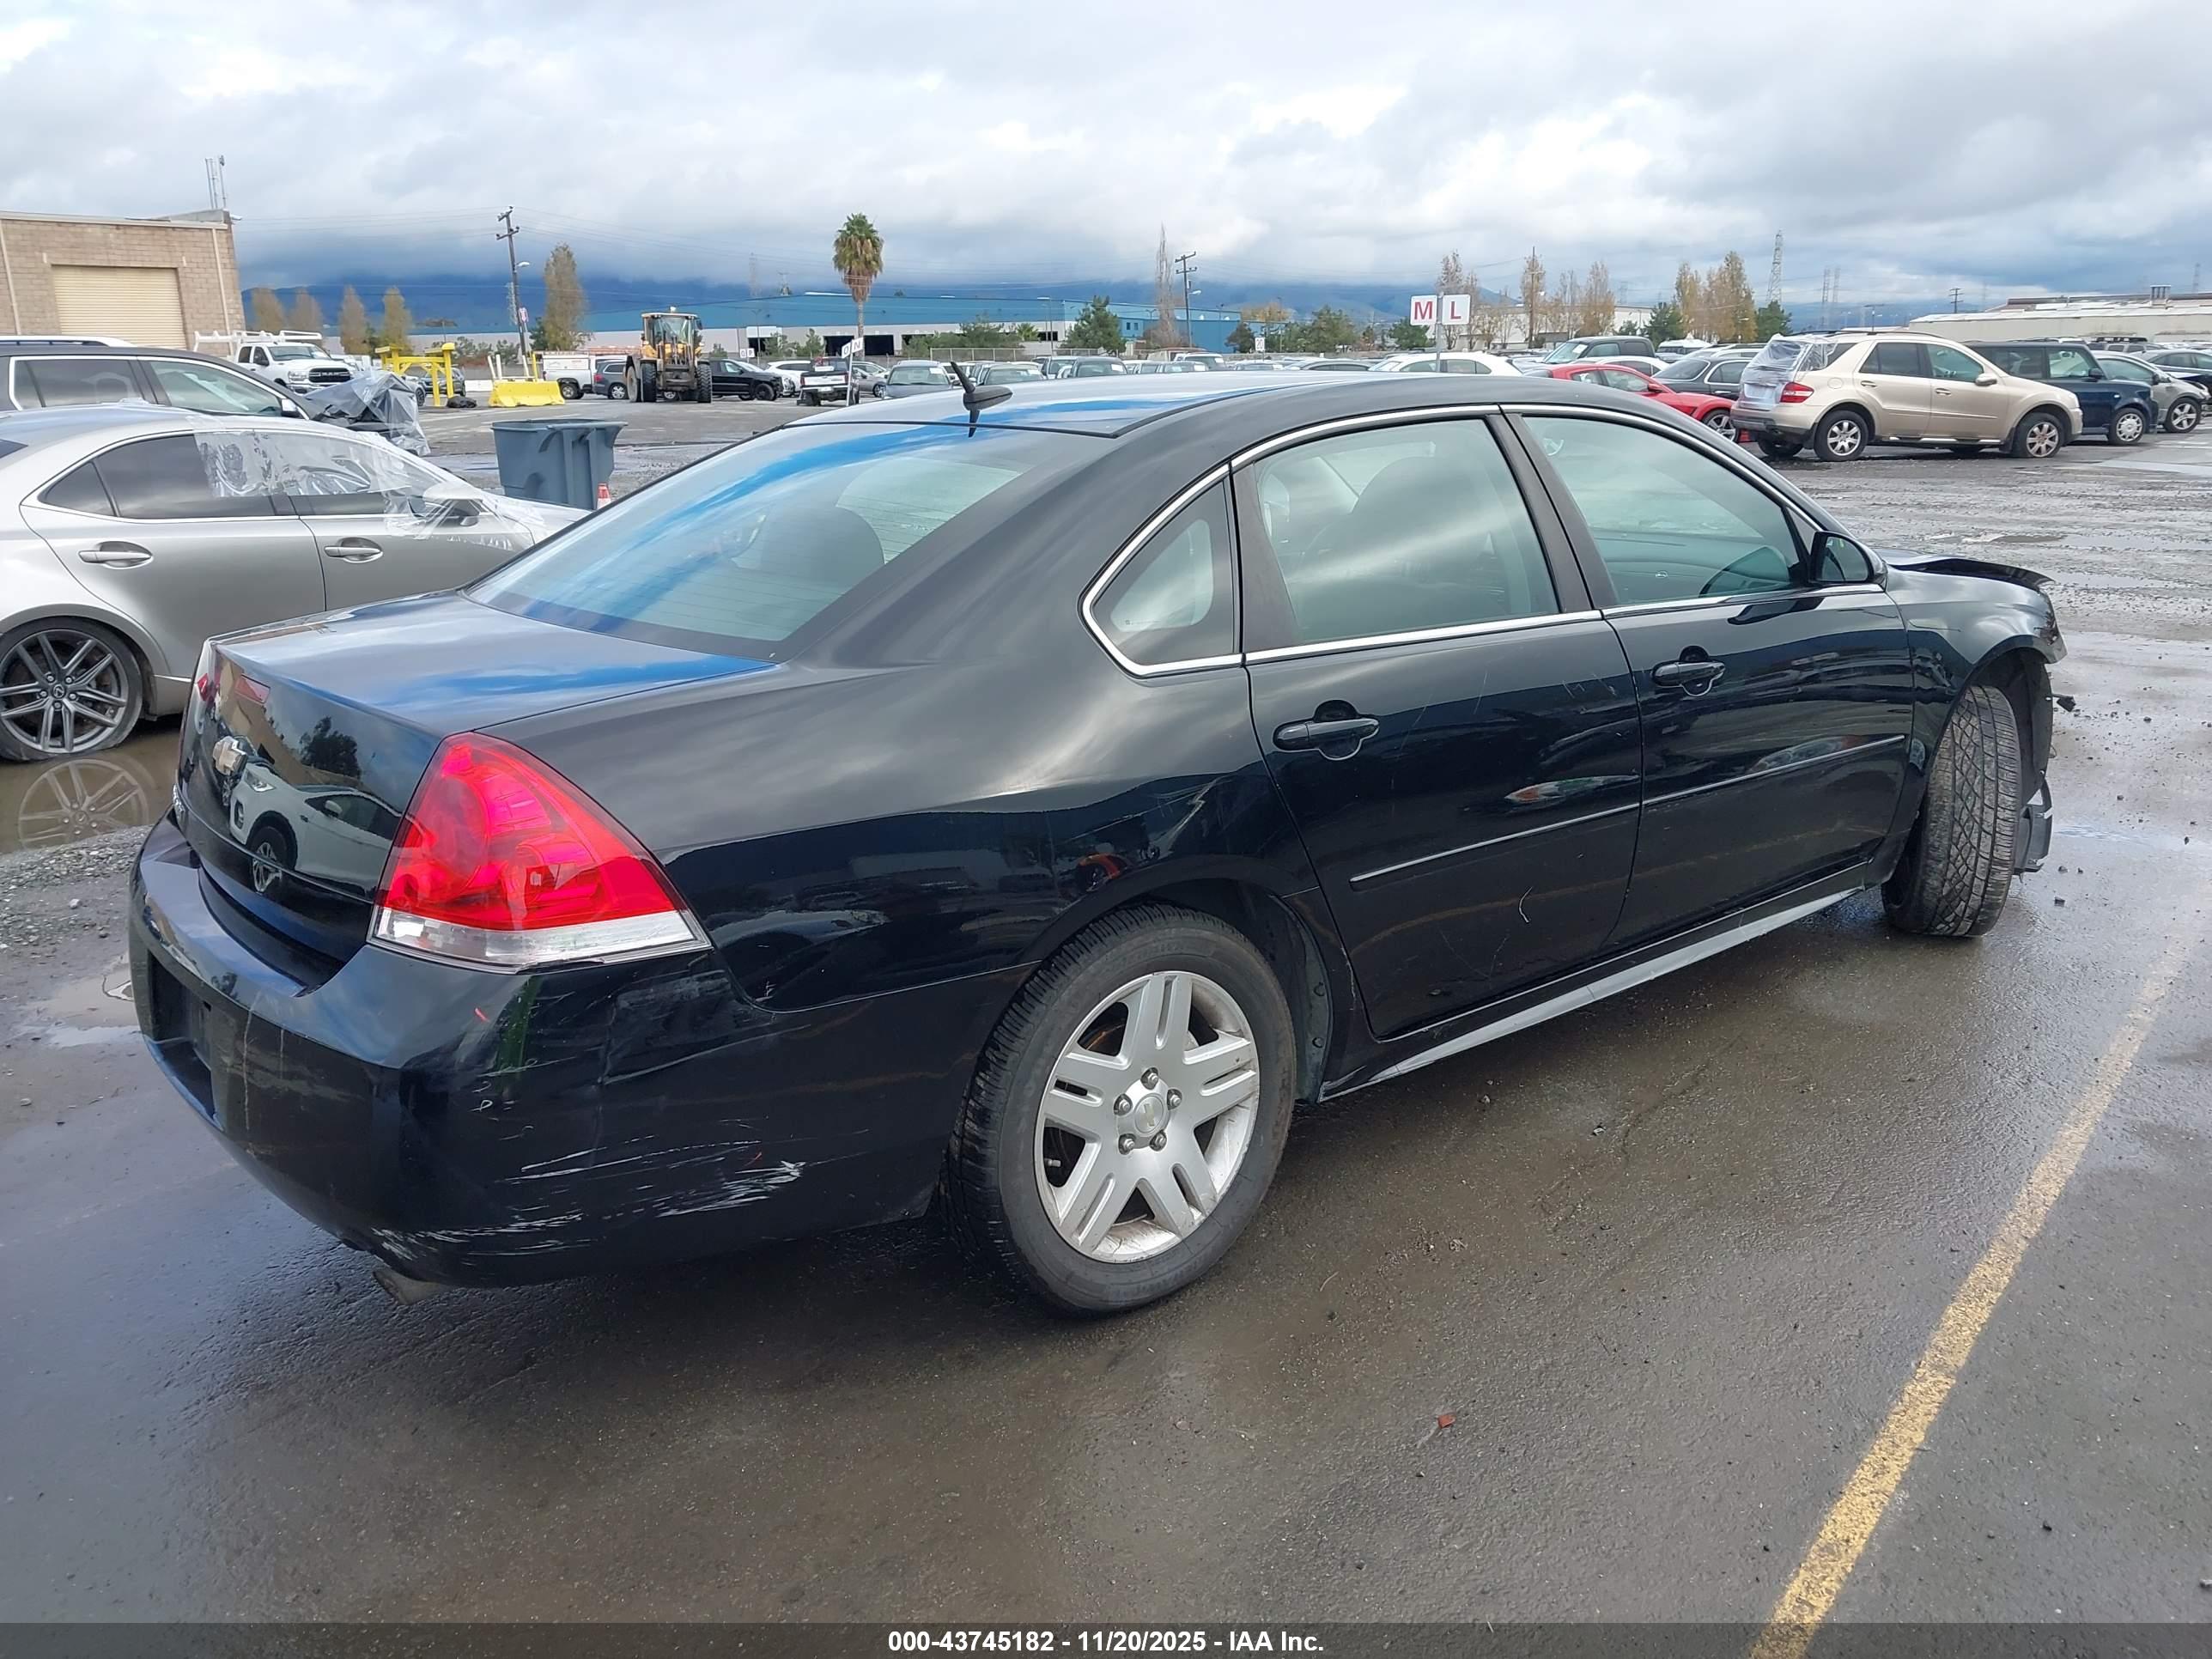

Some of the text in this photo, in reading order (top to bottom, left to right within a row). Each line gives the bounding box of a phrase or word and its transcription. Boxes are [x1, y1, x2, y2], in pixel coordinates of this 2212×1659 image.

[1413, 301, 1433, 320] M
[1449, 301, 1462, 319] L
[854, 341, 860, 350] N
